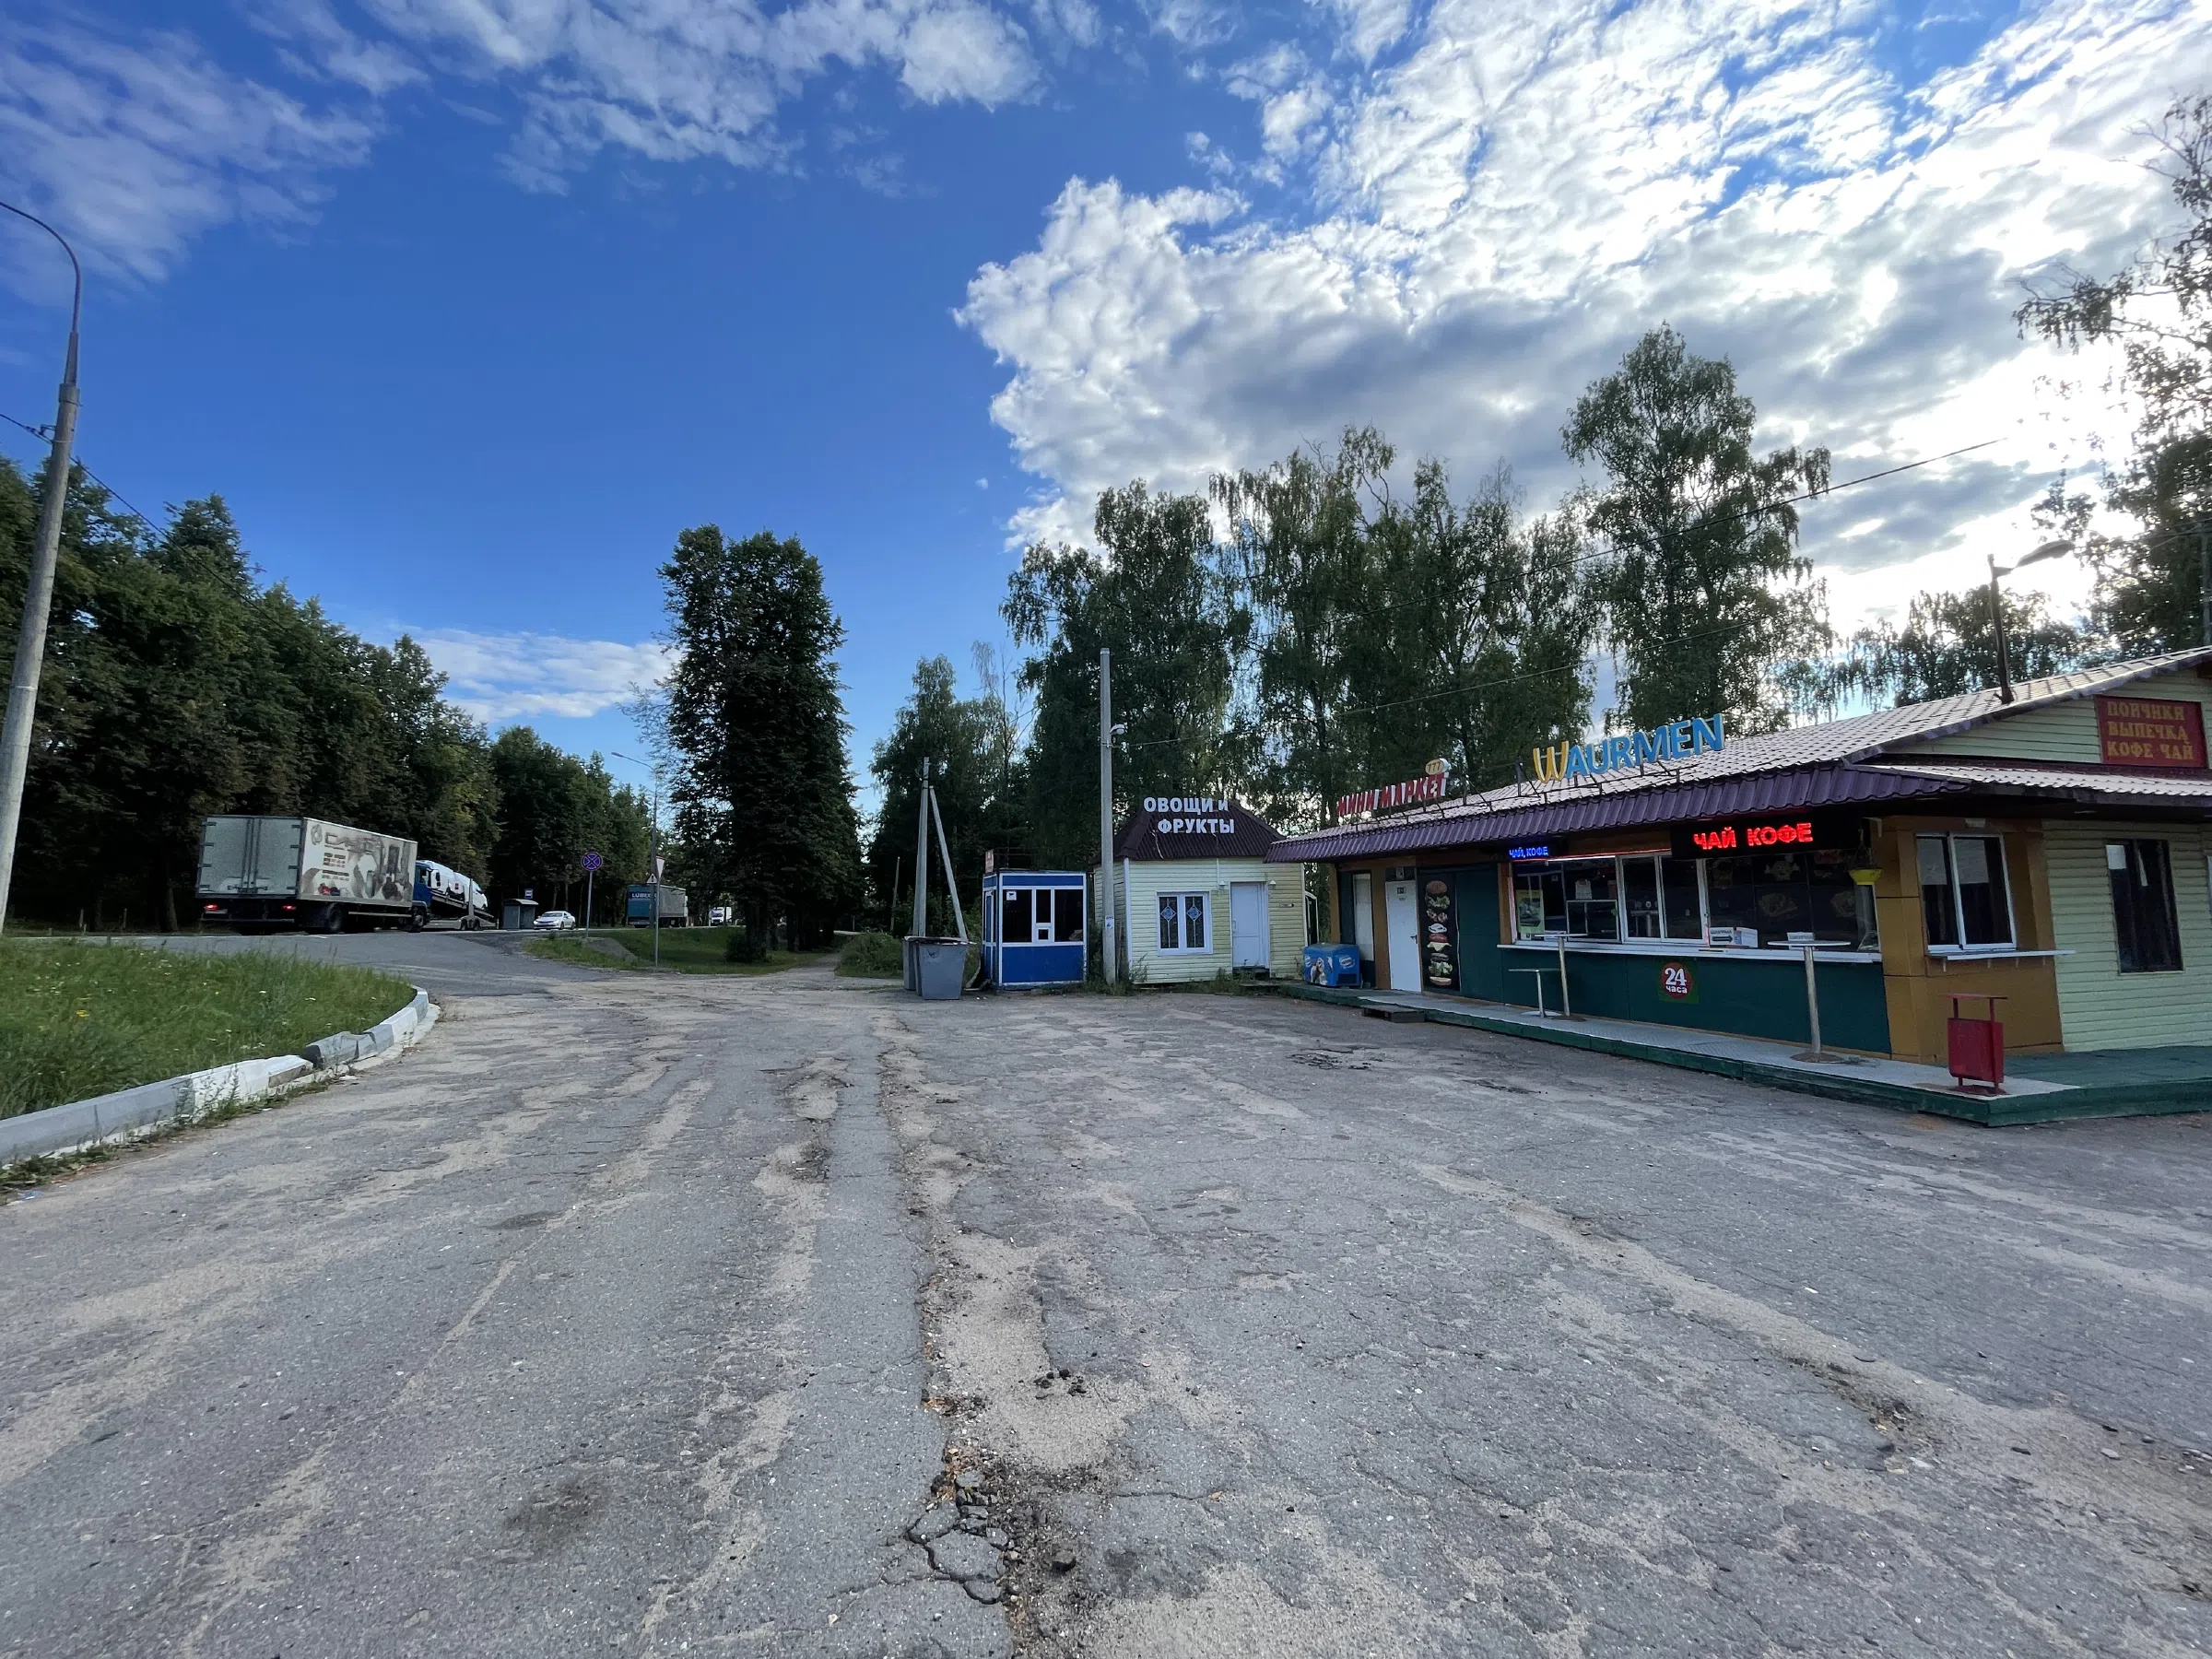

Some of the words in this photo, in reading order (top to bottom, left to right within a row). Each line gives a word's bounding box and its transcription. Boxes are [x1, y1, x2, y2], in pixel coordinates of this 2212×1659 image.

[2108, 721, 2189, 741] ВЫПЕЧКА
[2107, 740, 2154, 759] КОФЕ
[2159, 740, 2194, 759] ЧАЙ
[1336, 788, 1380, 817] МИНИ
[1380, 772, 1448, 809] МАРКЕТ
[1144, 797, 1214, 815] ОВОЩИ
[1158, 818, 1234, 834] ФРУКТЫ
[1693, 827, 1736, 850] ЧАЙ
[1747, 823, 1813, 846] КОФЕ
[1526, 846, 1548, 857] КОФЕ
[1665, 968, 1687, 986] 24
[1665, 985, 1688, 994] часа
